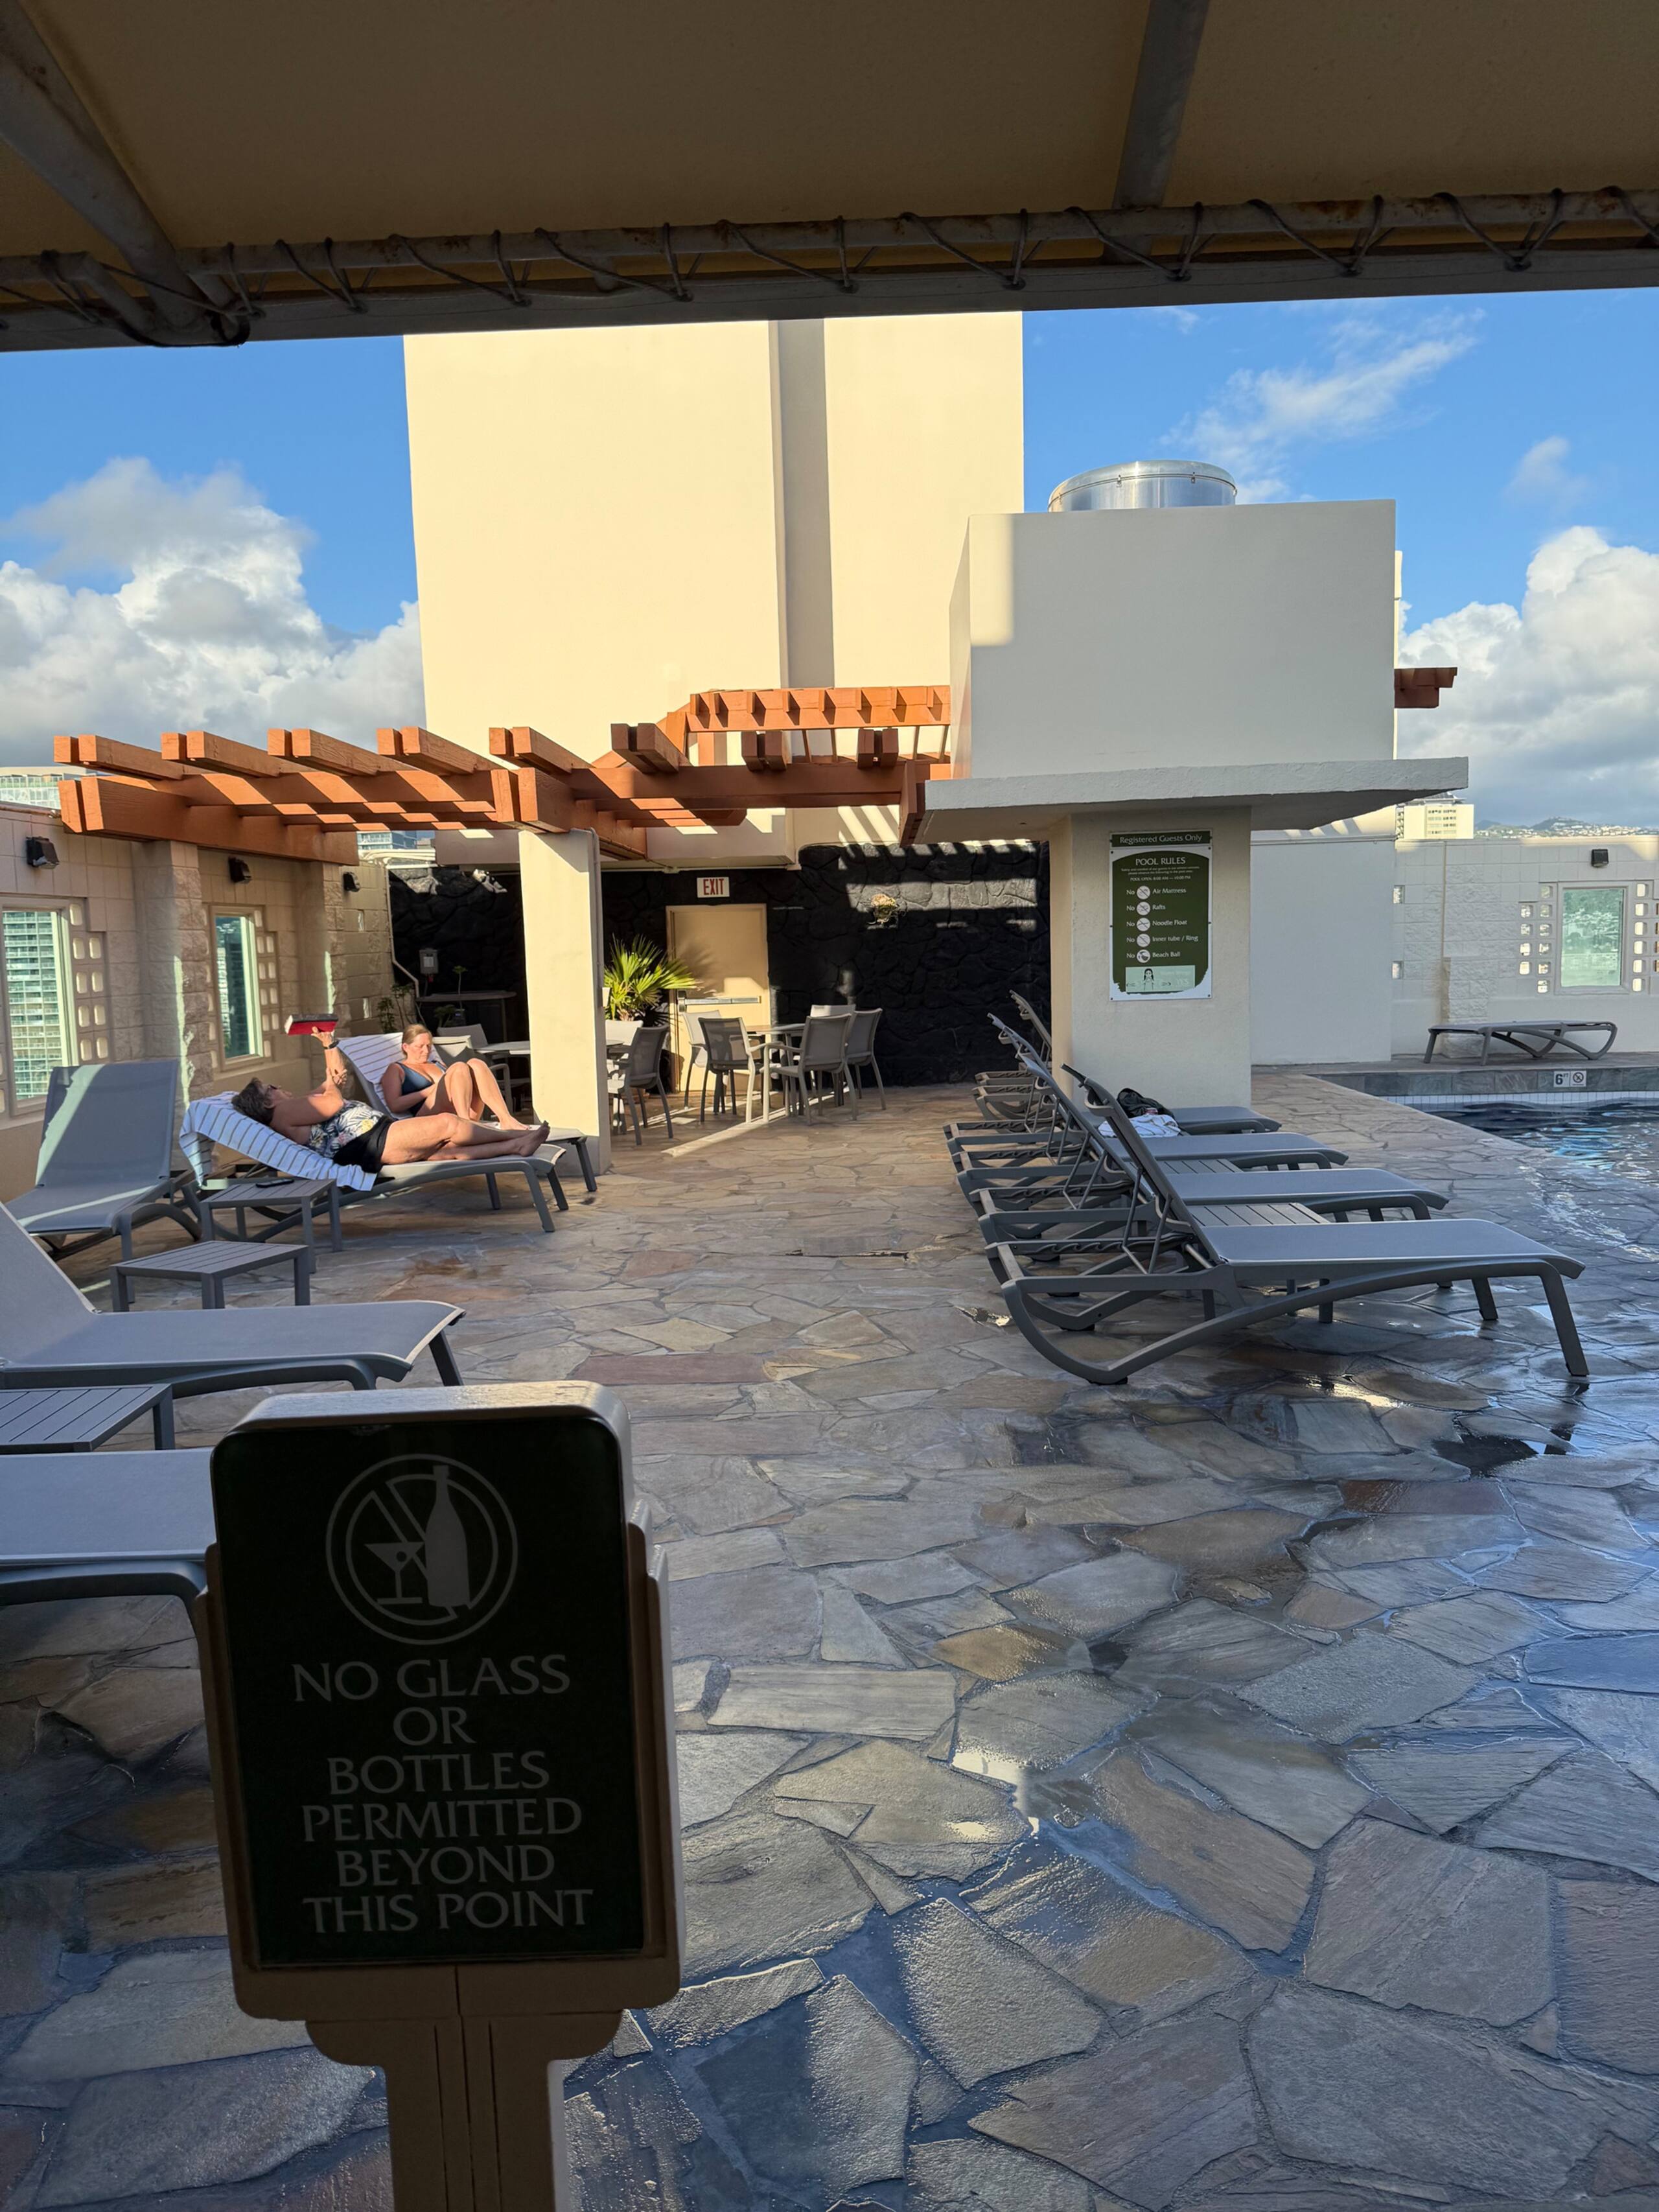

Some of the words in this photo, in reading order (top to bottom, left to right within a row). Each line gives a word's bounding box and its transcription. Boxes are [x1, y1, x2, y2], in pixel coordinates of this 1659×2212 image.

[1120, 836, 1157, 845] Registered
[1185, 833, 1203, 843] Only
[1161, 856, 1186, 865] RULES
[703, 878, 724, 895] EXIT
[1555, 1073, 1562, 1085] 6
[291, 1660, 379, 1702] NO
[396, 1654, 571, 1698] GLASS
[392, 1705, 478, 1746] OR
[326, 1750, 550, 1795] BOTTLES
[300, 1797, 583, 1843] PERMITTED
[335, 1844, 555, 1887] BEYOND
[302, 1893, 419, 1934] THIS
[435, 1888, 594, 1929] POINT
